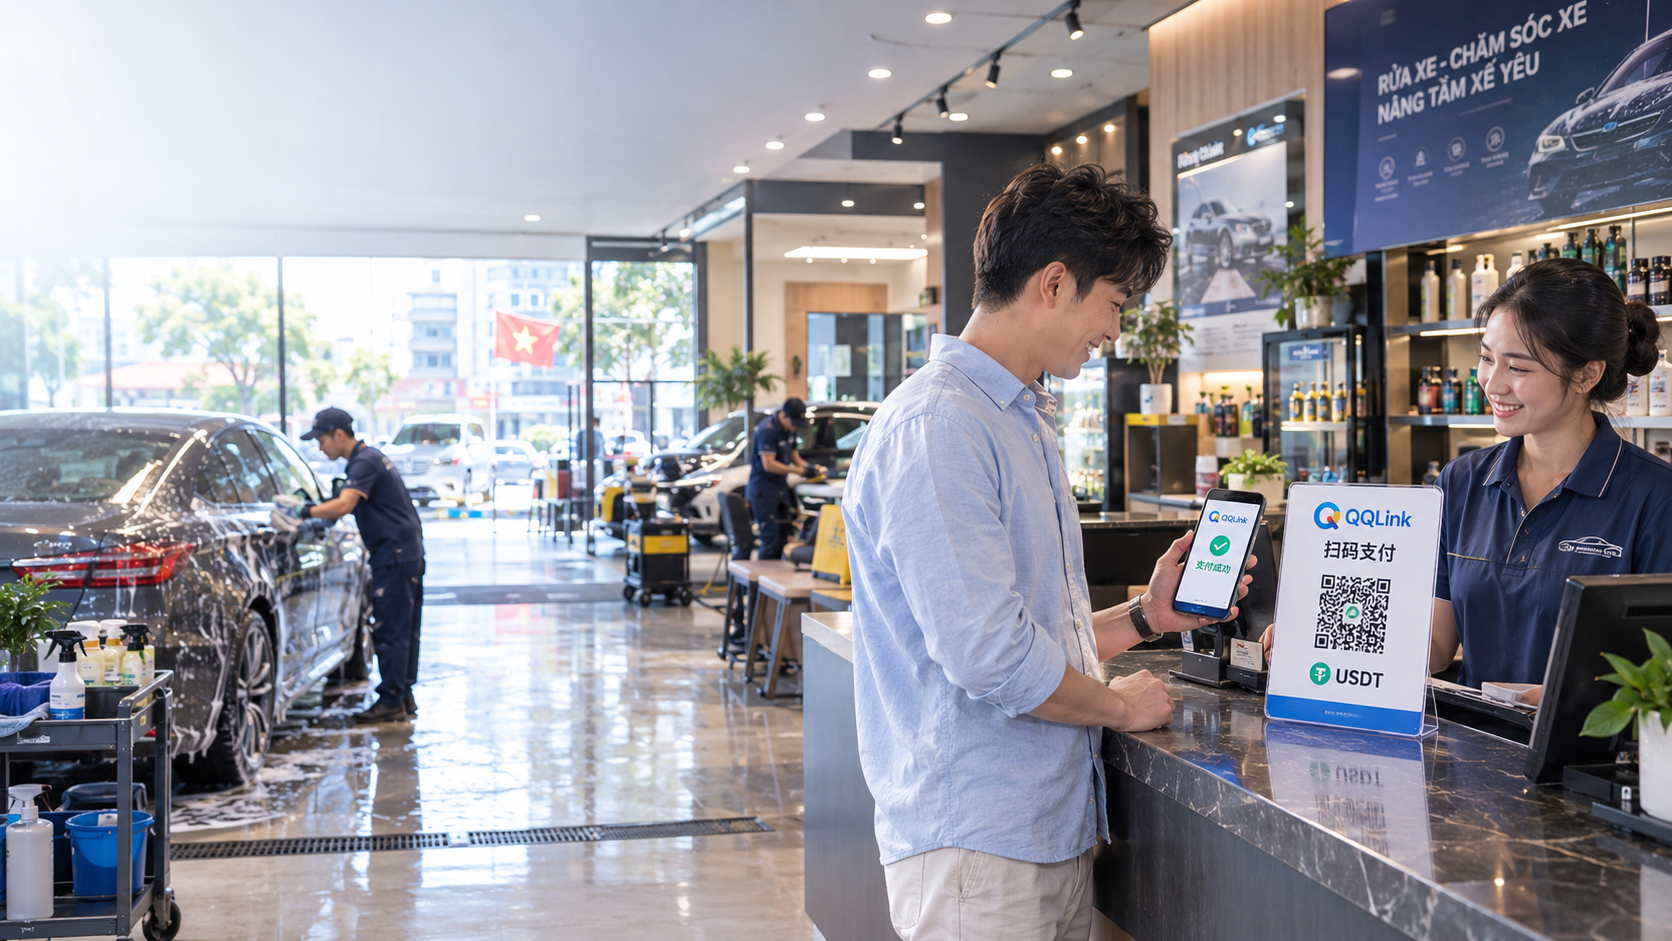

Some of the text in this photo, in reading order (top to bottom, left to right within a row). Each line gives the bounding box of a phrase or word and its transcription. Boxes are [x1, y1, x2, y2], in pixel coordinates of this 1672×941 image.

[1378, 63, 1412, 96] RỬA
[1415, 55, 1438, 83] XE
[1449, 31, 1505, 70] CHĂM
[1510, 13, 1553, 49] SÓC
[1557, 0, 1588, 33] XE
[1377, 91, 1425, 125] NÂNG
[1470, 58, 1498, 95] XẾ
[1499, 51, 1540, 84] YÊU
[1221, 514, 1248, 525] QQLink
[1345, 508, 1412, 528] QQLink
[1323, 540, 1396, 563] 扫码支付
[1335, 668, 1384, 689] USDT
